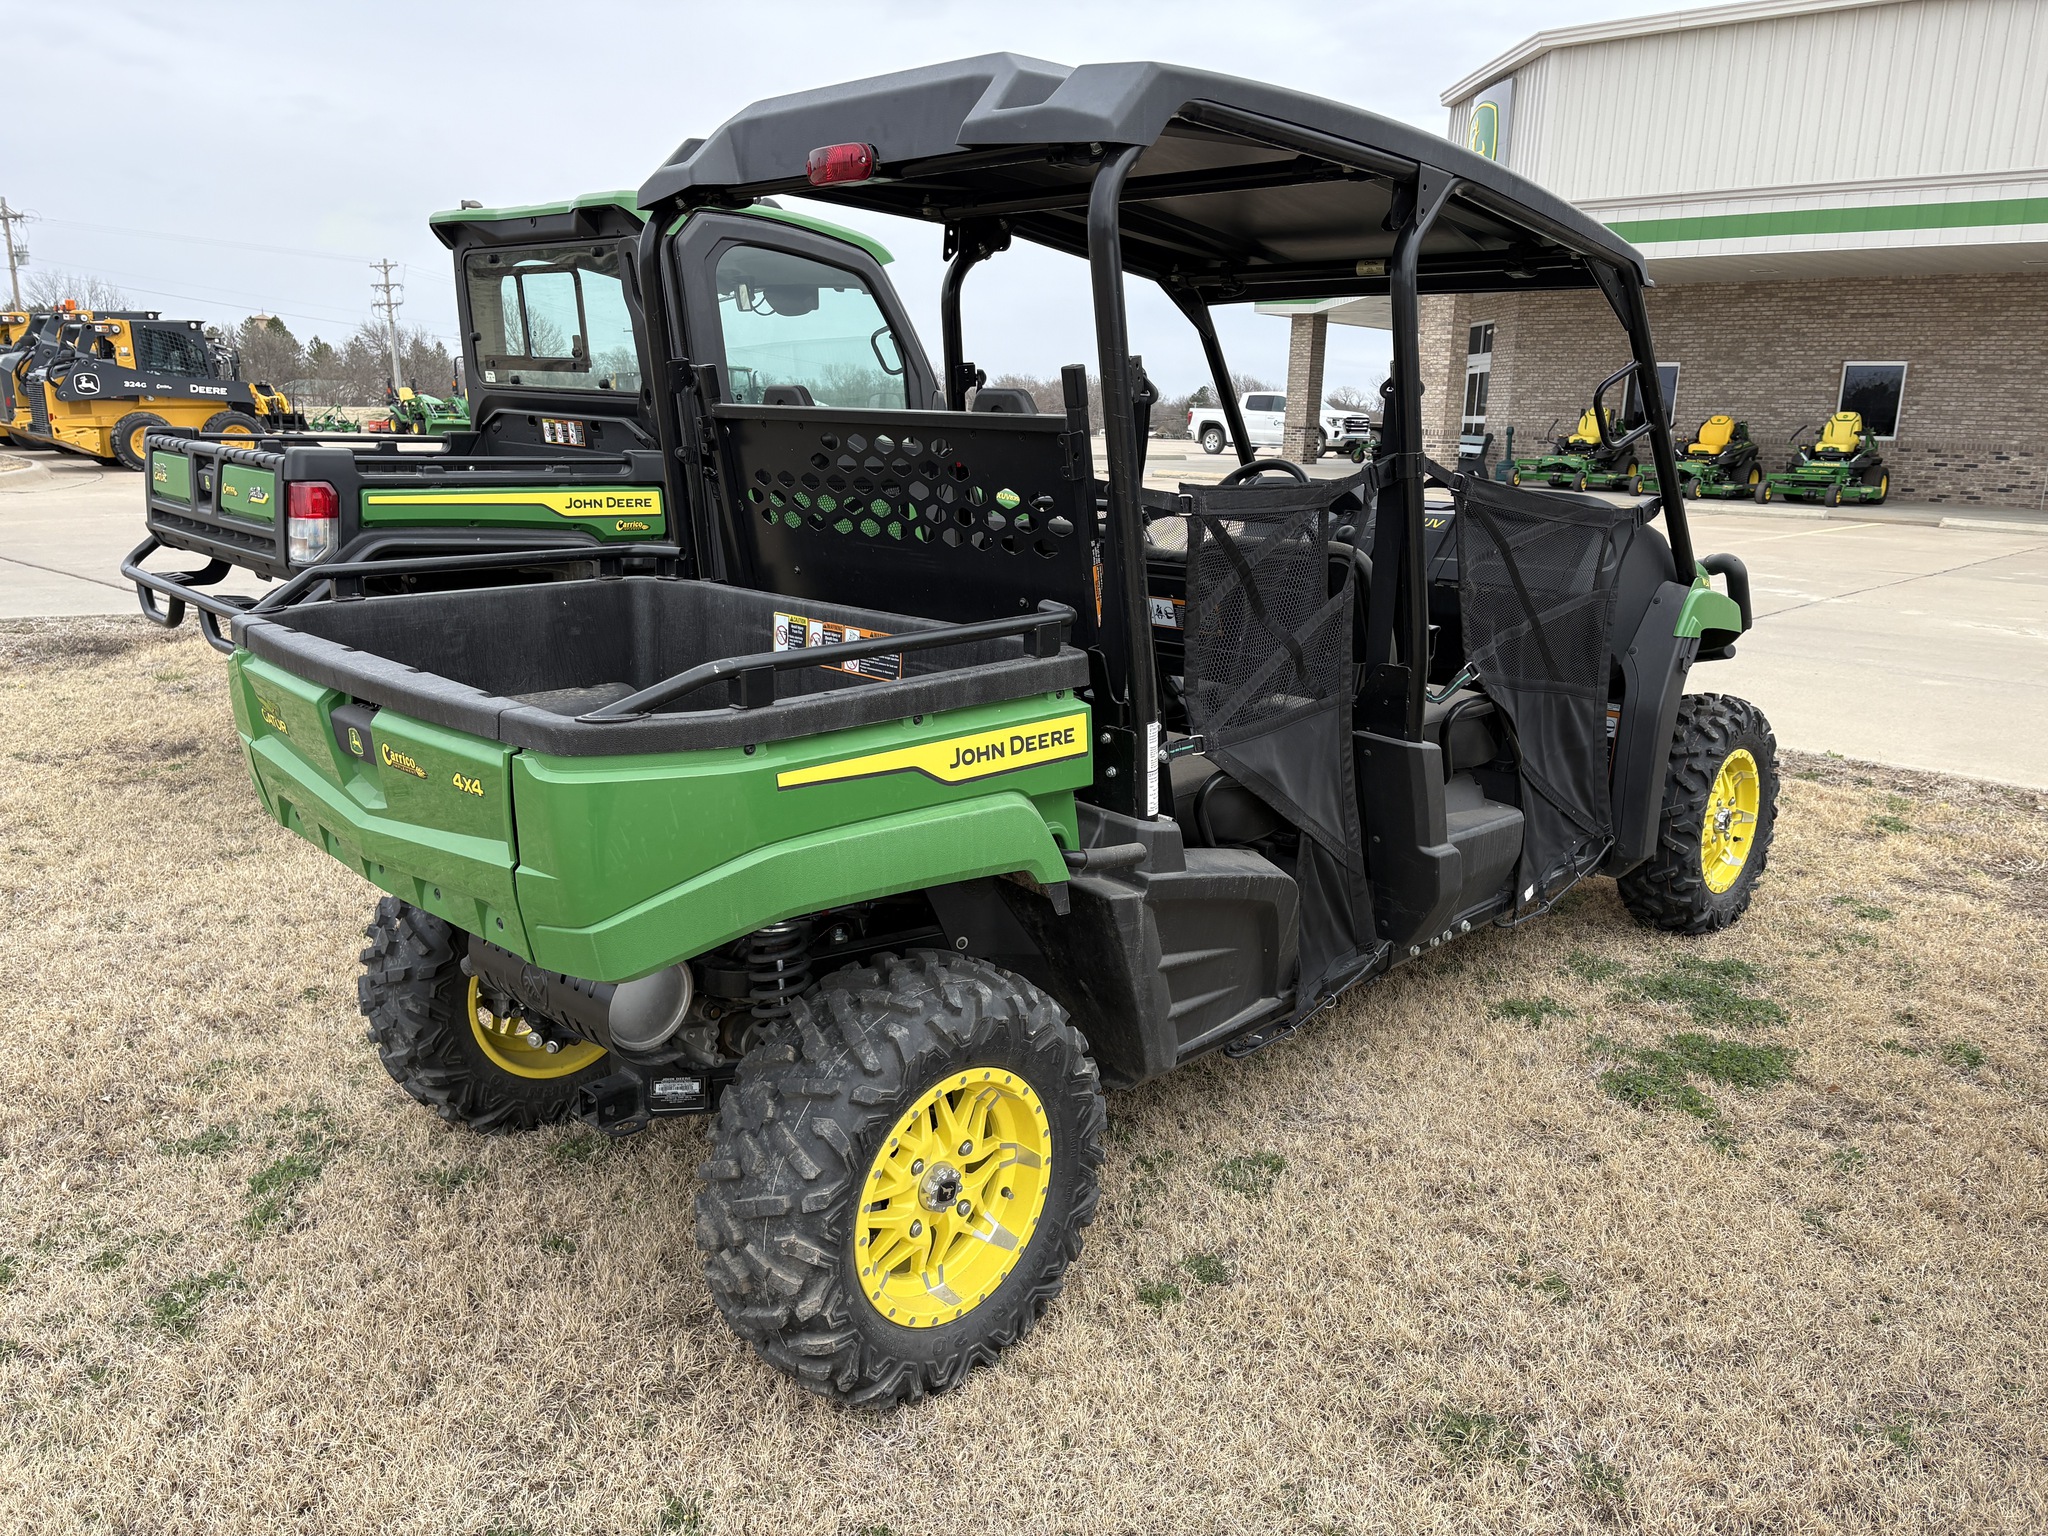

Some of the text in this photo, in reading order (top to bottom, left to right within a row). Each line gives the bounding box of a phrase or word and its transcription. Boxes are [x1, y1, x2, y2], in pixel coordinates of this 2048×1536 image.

[123, 380, 147, 389] 324G
[189, 384, 228, 396] DEERE
[565, 497, 652, 509] JOHN DEERE
[615, 519, 643, 532] Carrico
[381, 742, 417, 770] Carrico
[949, 727, 1076, 770] JOHN DEERE
